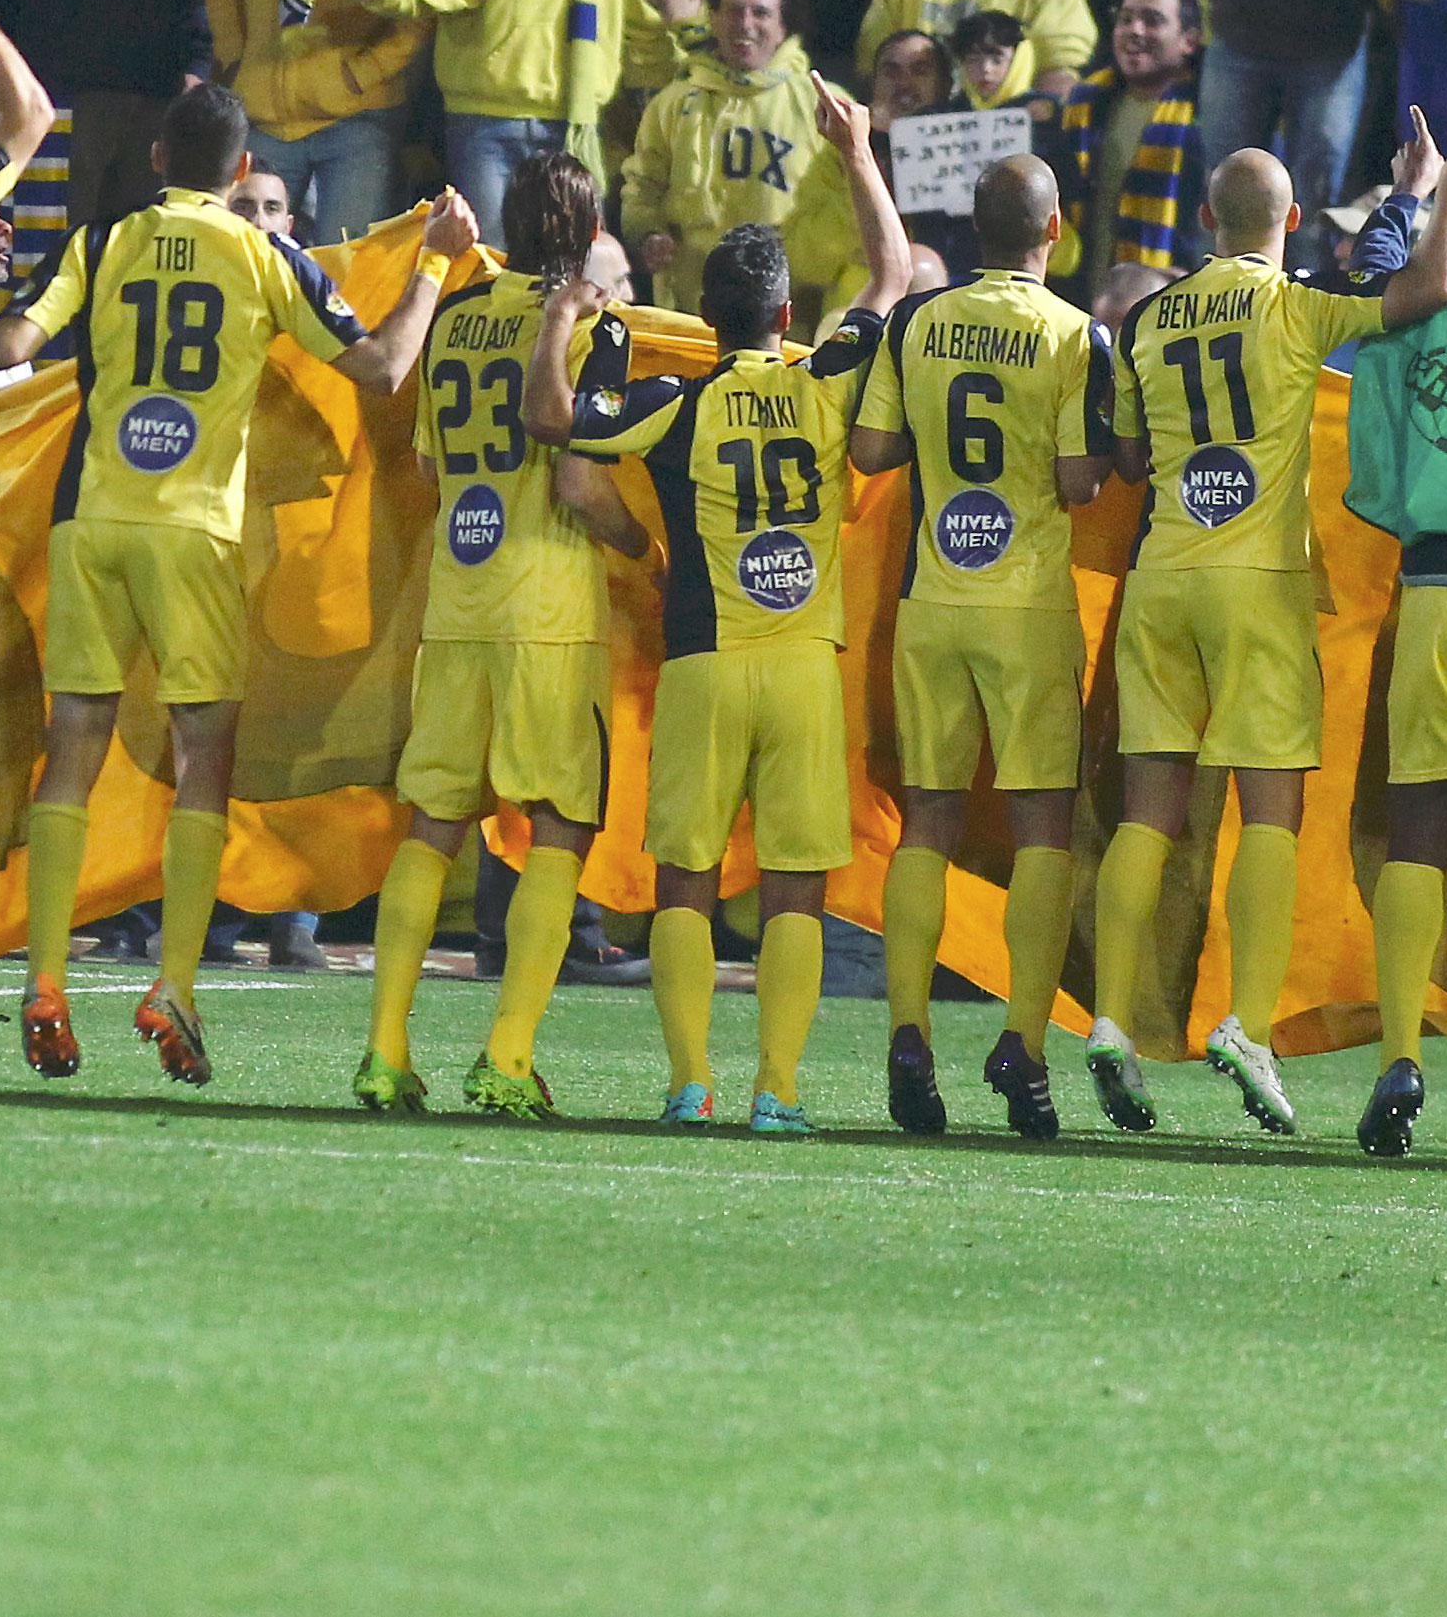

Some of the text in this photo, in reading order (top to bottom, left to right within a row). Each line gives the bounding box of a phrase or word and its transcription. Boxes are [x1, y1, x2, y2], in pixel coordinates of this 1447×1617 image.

[154, 236, 196, 273] TIBI
[1156, 287, 1255, 330] BEN HAIM
[121, 279, 225, 392] 18
[923, 321, 1040, 369] ALBERMAN
[1163, 332, 1256, 446] 11
[432, 357, 527, 476] 23
[128, 417, 190, 439] NIVEA
[947, 372, 1005, 485] 6
[130, 437, 182, 454] MEN
[717, 437, 823, 533] 10
[1190, 470, 1250, 488] NIVEA
[1194, 488, 1243, 506] MEN
[455, 509, 501, 526] NIVEA
[946, 513, 1007, 531] NIVEA
[457, 528, 496, 545] MEN
[950, 532, 1000, 548] MEN
[747, 554, 808, 572] NIVEA
